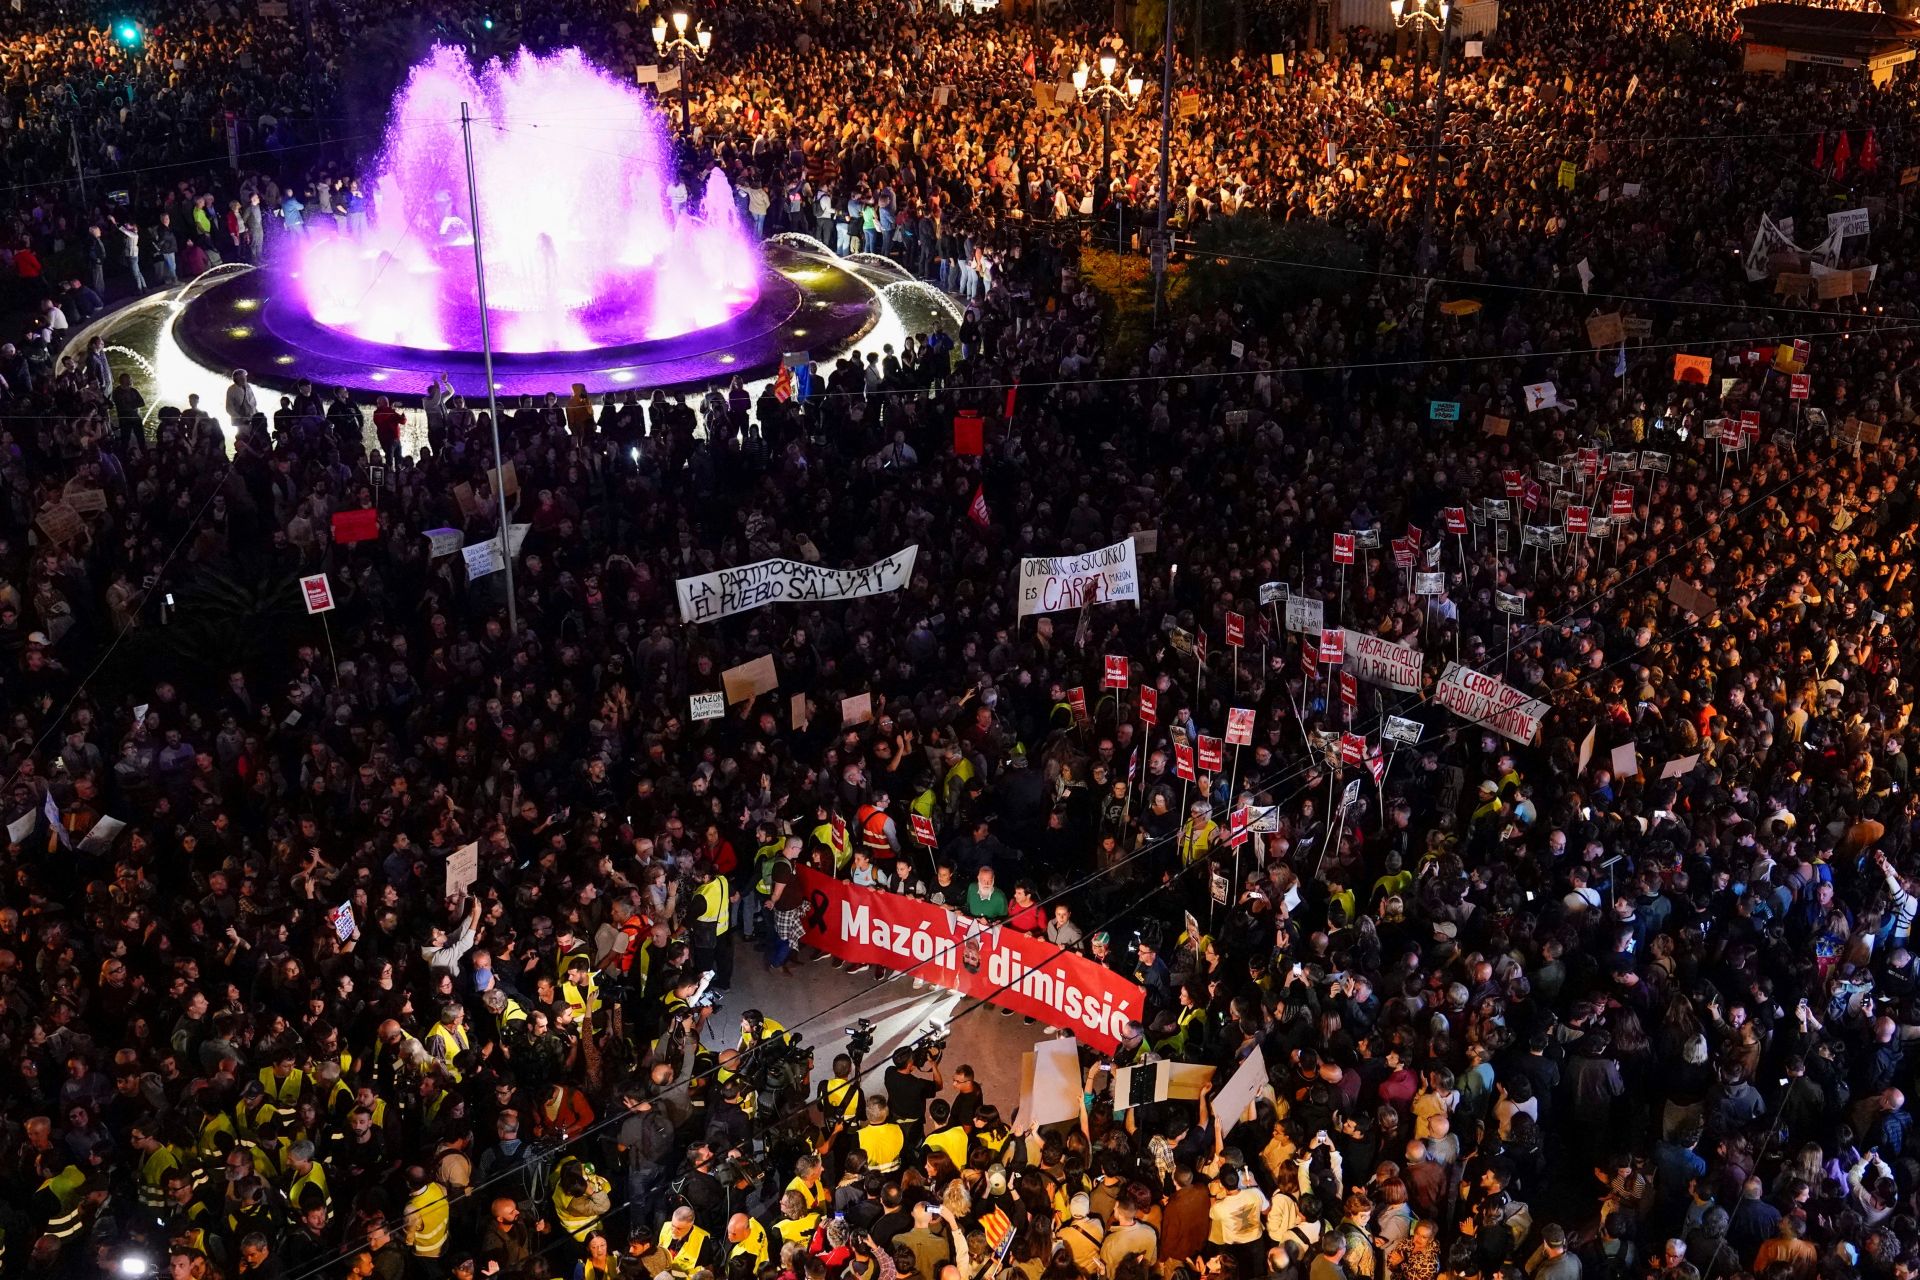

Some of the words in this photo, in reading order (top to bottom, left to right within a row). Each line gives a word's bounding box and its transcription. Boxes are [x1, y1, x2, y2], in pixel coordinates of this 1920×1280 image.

[1070, 561, 1080, 574] DE
[1081, 543, 1126, 573] SOCORRO
[690, 581, 714, 601] LA
[696, 598, 717, 620] EL
[720, 581, 784, 613] PUEBLO
[1026, 588, 1038, 600] ES
[1357, 636, 1384, 656] HASTA
[1382, 645, 1392, 662] EL
[1392, 648, 1421, 669] CUELLO
[1372, 660, 1387, 682] POR
[1440, 682, 1476, 714] PUEBLO
[1448, 666, 1460, 686] EL
[1464, 672, 1498, 698] CERDO
[1535, 702, 1541, 710] Y
[841, 900, 956, 970] Mazón
[989, 946, 1130, 1043] dimissió
